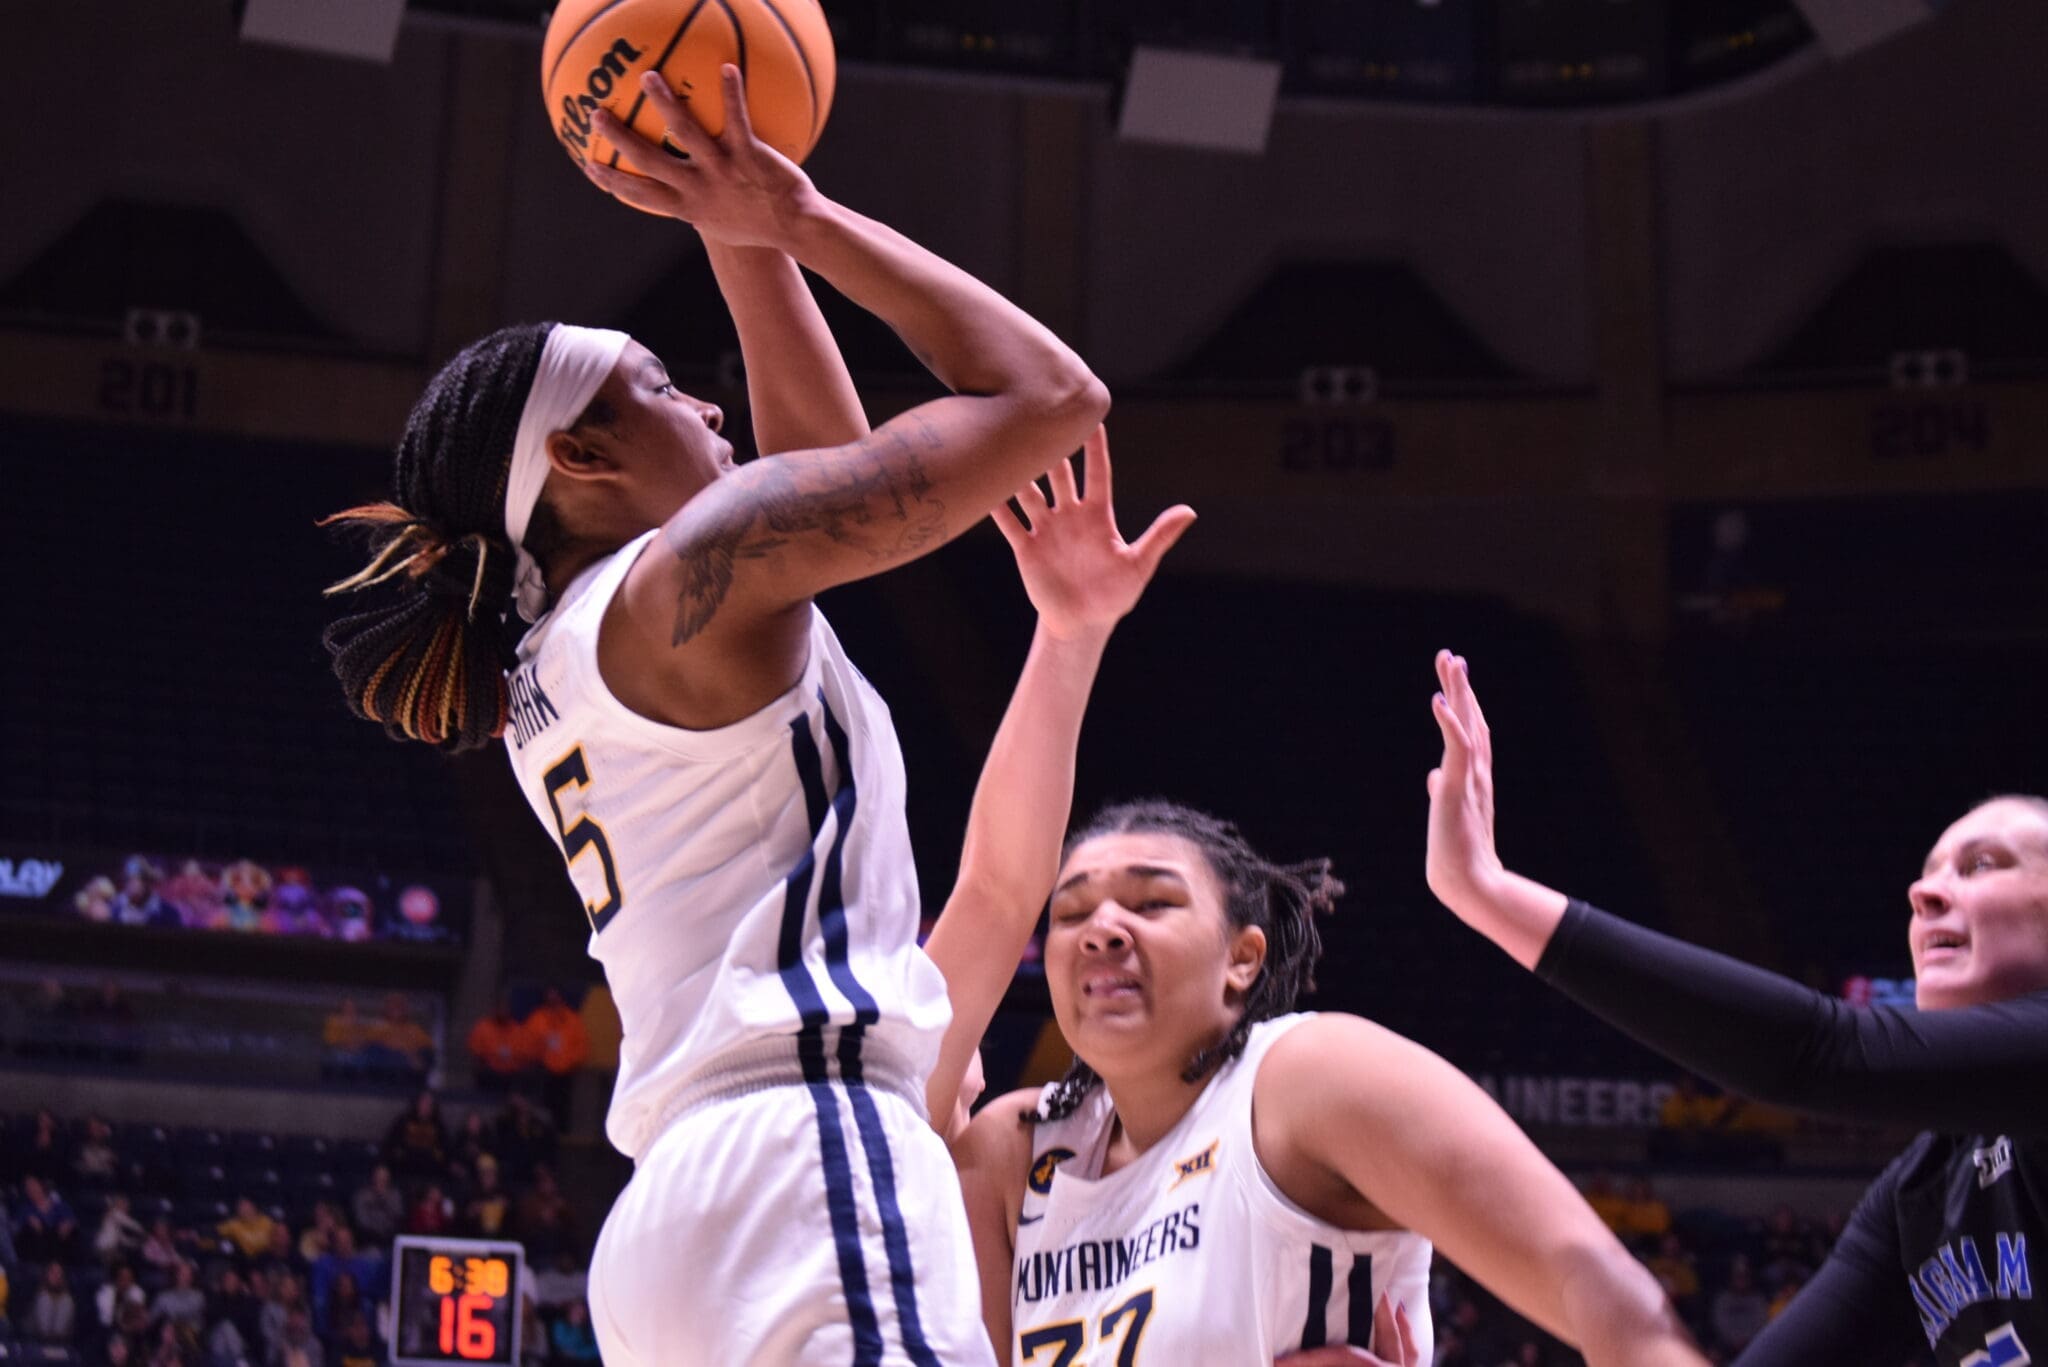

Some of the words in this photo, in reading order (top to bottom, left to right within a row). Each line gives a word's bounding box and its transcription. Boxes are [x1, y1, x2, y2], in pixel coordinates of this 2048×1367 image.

[559, 37, 643, 166] ilson
[99, 358, 196, 416] 201
[1280, 417, 1393, 471] 203
[1871, 402, 1988, 459] 204
[542, 740, 627, 936] 5
[439, 1293, 496, 1359] 16
